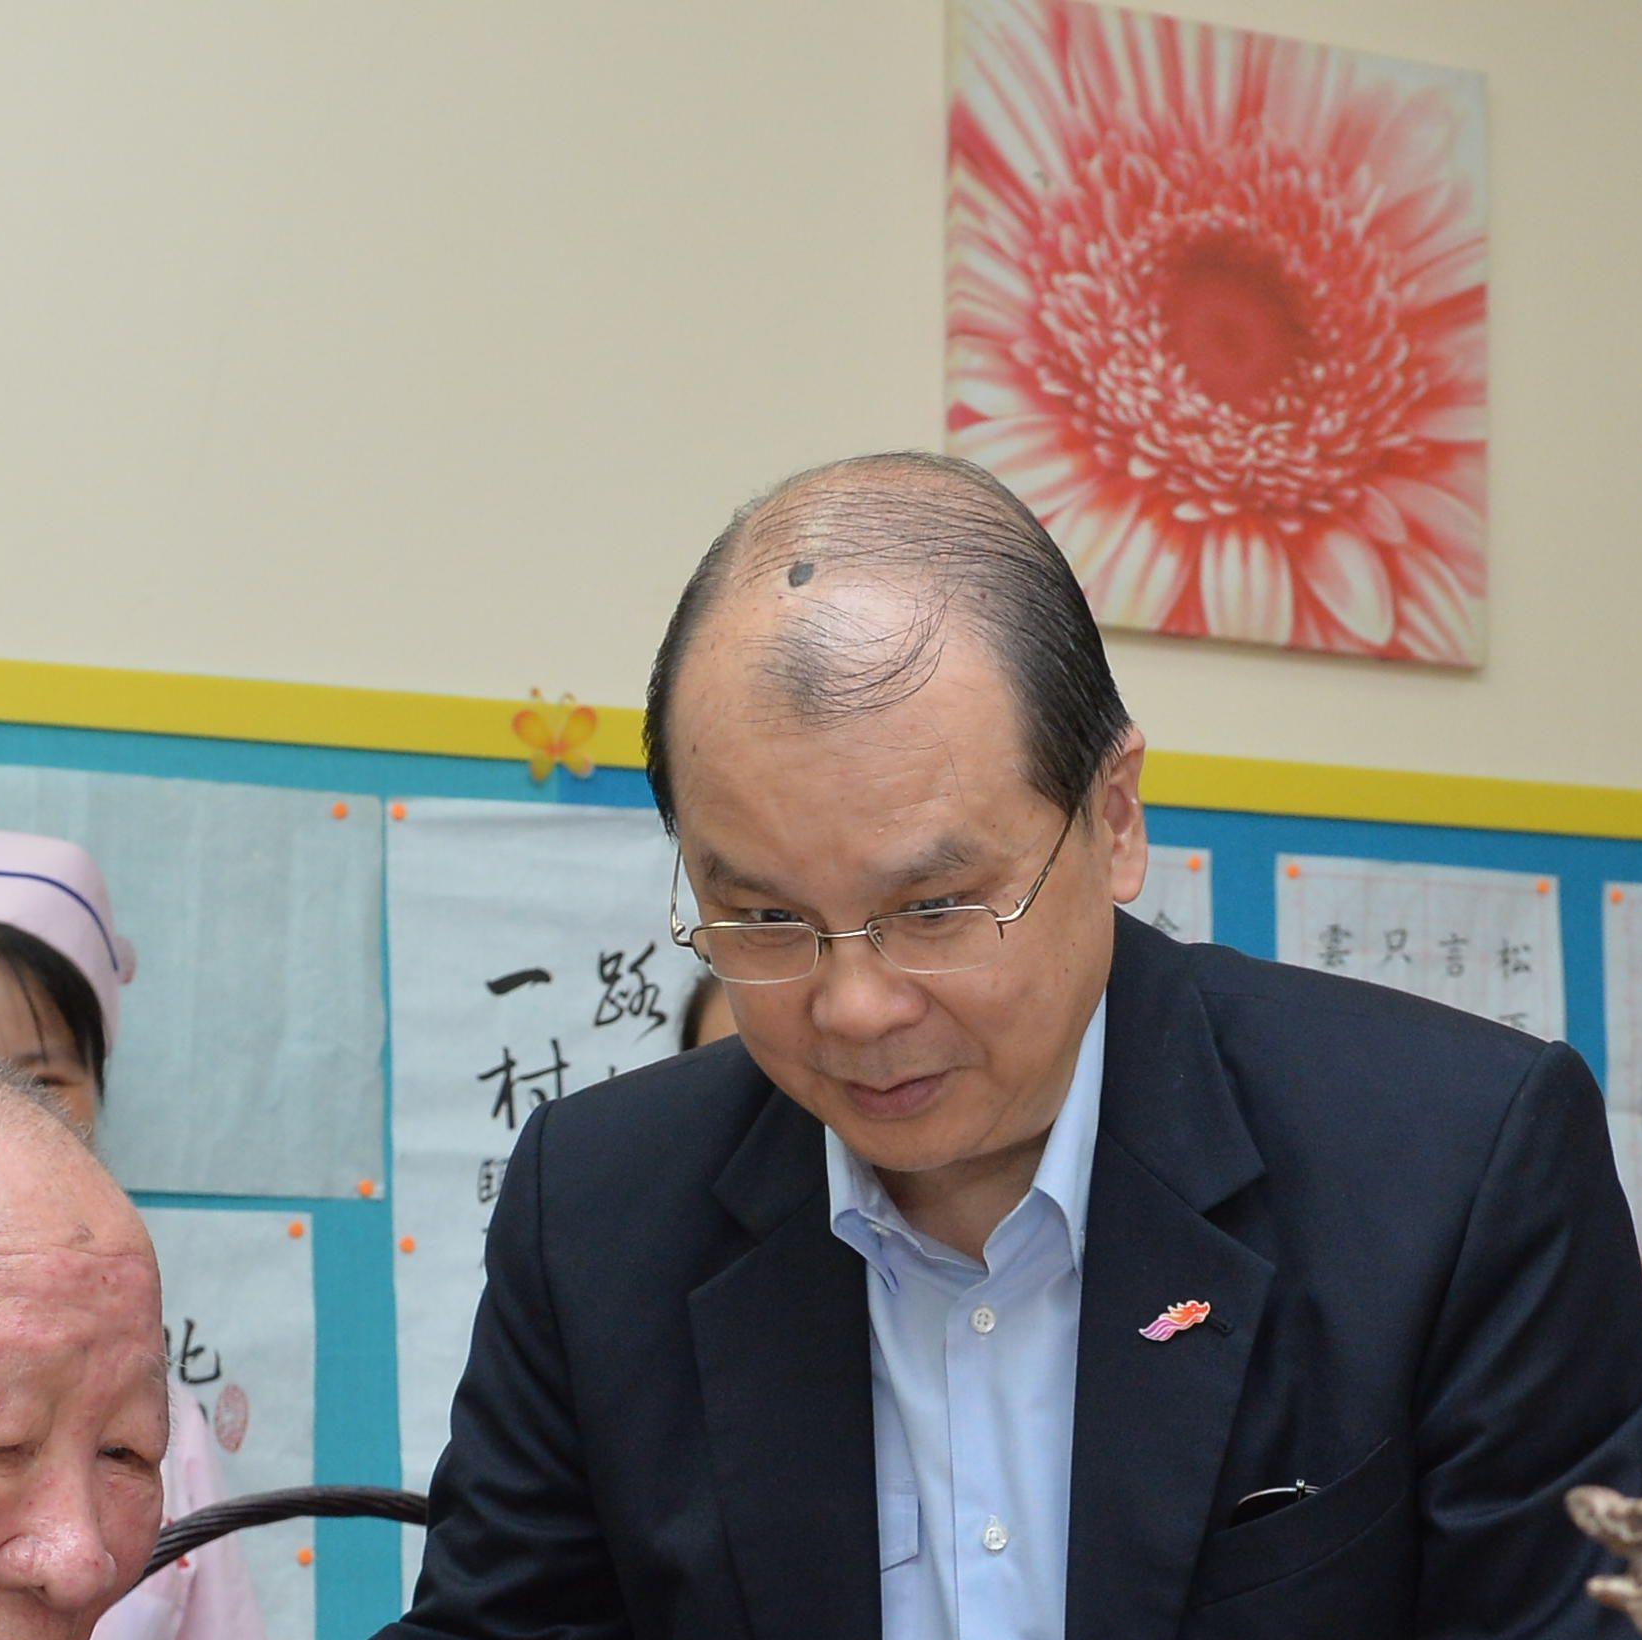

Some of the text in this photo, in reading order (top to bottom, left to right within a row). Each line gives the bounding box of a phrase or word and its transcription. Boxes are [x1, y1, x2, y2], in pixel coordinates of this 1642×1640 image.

[1317, 922, 1354, 969] 雲
[1380, 927, 1414, 968] 只
[1438, 932, 1470, 979] 言
